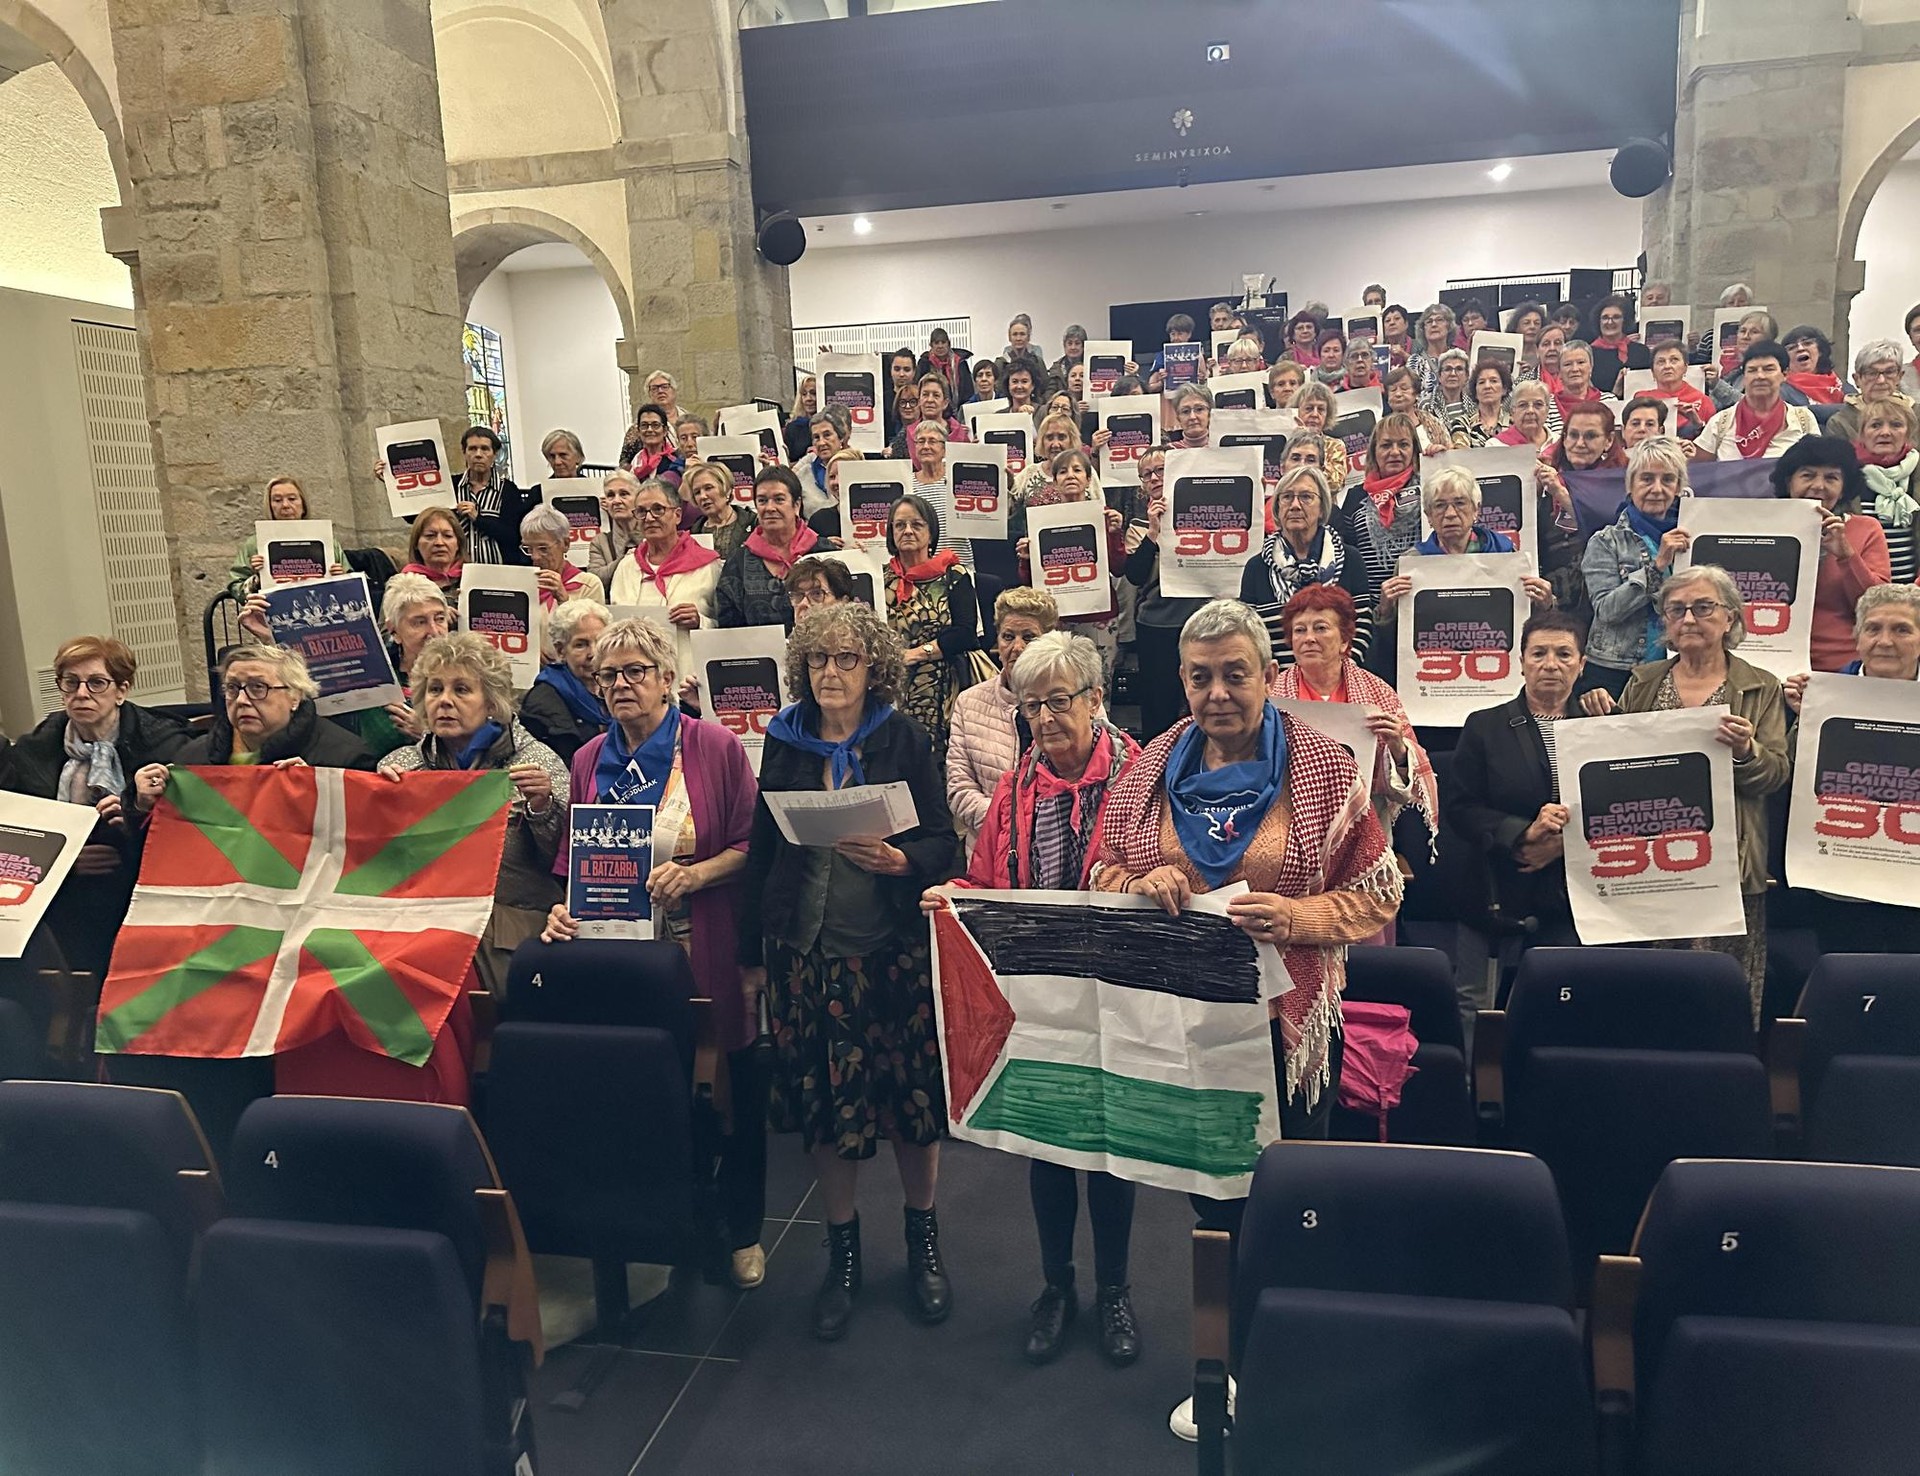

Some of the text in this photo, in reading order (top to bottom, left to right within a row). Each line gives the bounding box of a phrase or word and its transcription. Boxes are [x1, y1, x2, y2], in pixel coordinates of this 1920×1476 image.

[851, 409, 875, 424] 0
[395, 470, 442, 491] 30
[954, 496, 999, 513] 30
[1189, 505, 1235, 513] GREBA
[1176, 512, 1248, 520] FEMINISTA
[1175, 519, 1248, 528] OROKORRA
[1174, 528, 1250, 556] 30
[1042, 550, 1095, 560] FEMINISTA
[1051, 546, 1085, 554] GREBA
[1042, 556, 1096, 566] OROKORRA
[1043, 564, 1098, 586] 30
[1726, 571, 1773, 582] REBA
[1737, 581, 1790, 591] NISTA
[1740, 590, 1790, 601] ORRA
[471, 617, 526, 627] FEMINISTA
[482, 611, 517, 620] GREBA
[471, 623, 527, 632] OROKORRA
[1434, 621, 1492, 632] GREBA
[1417, 630, 1508, 640] FEMINISTA
[308, 634, 367, 656] BATZARRA
[1417, 639, 1509, 649] OROKORRA
[1415, 648, 1511, 683] 30
[712, 692, 776, 702] FEMINISTA
[723, 686, 764, 695] GREBA
[714, 700, 778, 710] OROKORRA
[1845, 761, 1920, 779] GREBA
[1821, 770, 1920, 791] FEMINIS
[1820, 782, 1920, 802] OROKOR
[1609, 796, 1684, 815] GREBA
[1588, 806, 1706, 827] FEMINISTA
[1814, 792, 1920, 845] 30
[1588, 817, 1708, 838] OROKORRA
[1586, 829, 1713, 879] 30
[592, 860, 639, 877] BATZARRA
[531, 973, 543, 987] 4
[1560, 987, 1571, 1001] 5
[1862, 995, 1876, 1011] 7
[264, 1150, 279, 1169] 4
[1302, 1209, 1318, 1229] 3
[1721, 1231, 1739, 1252] 5
